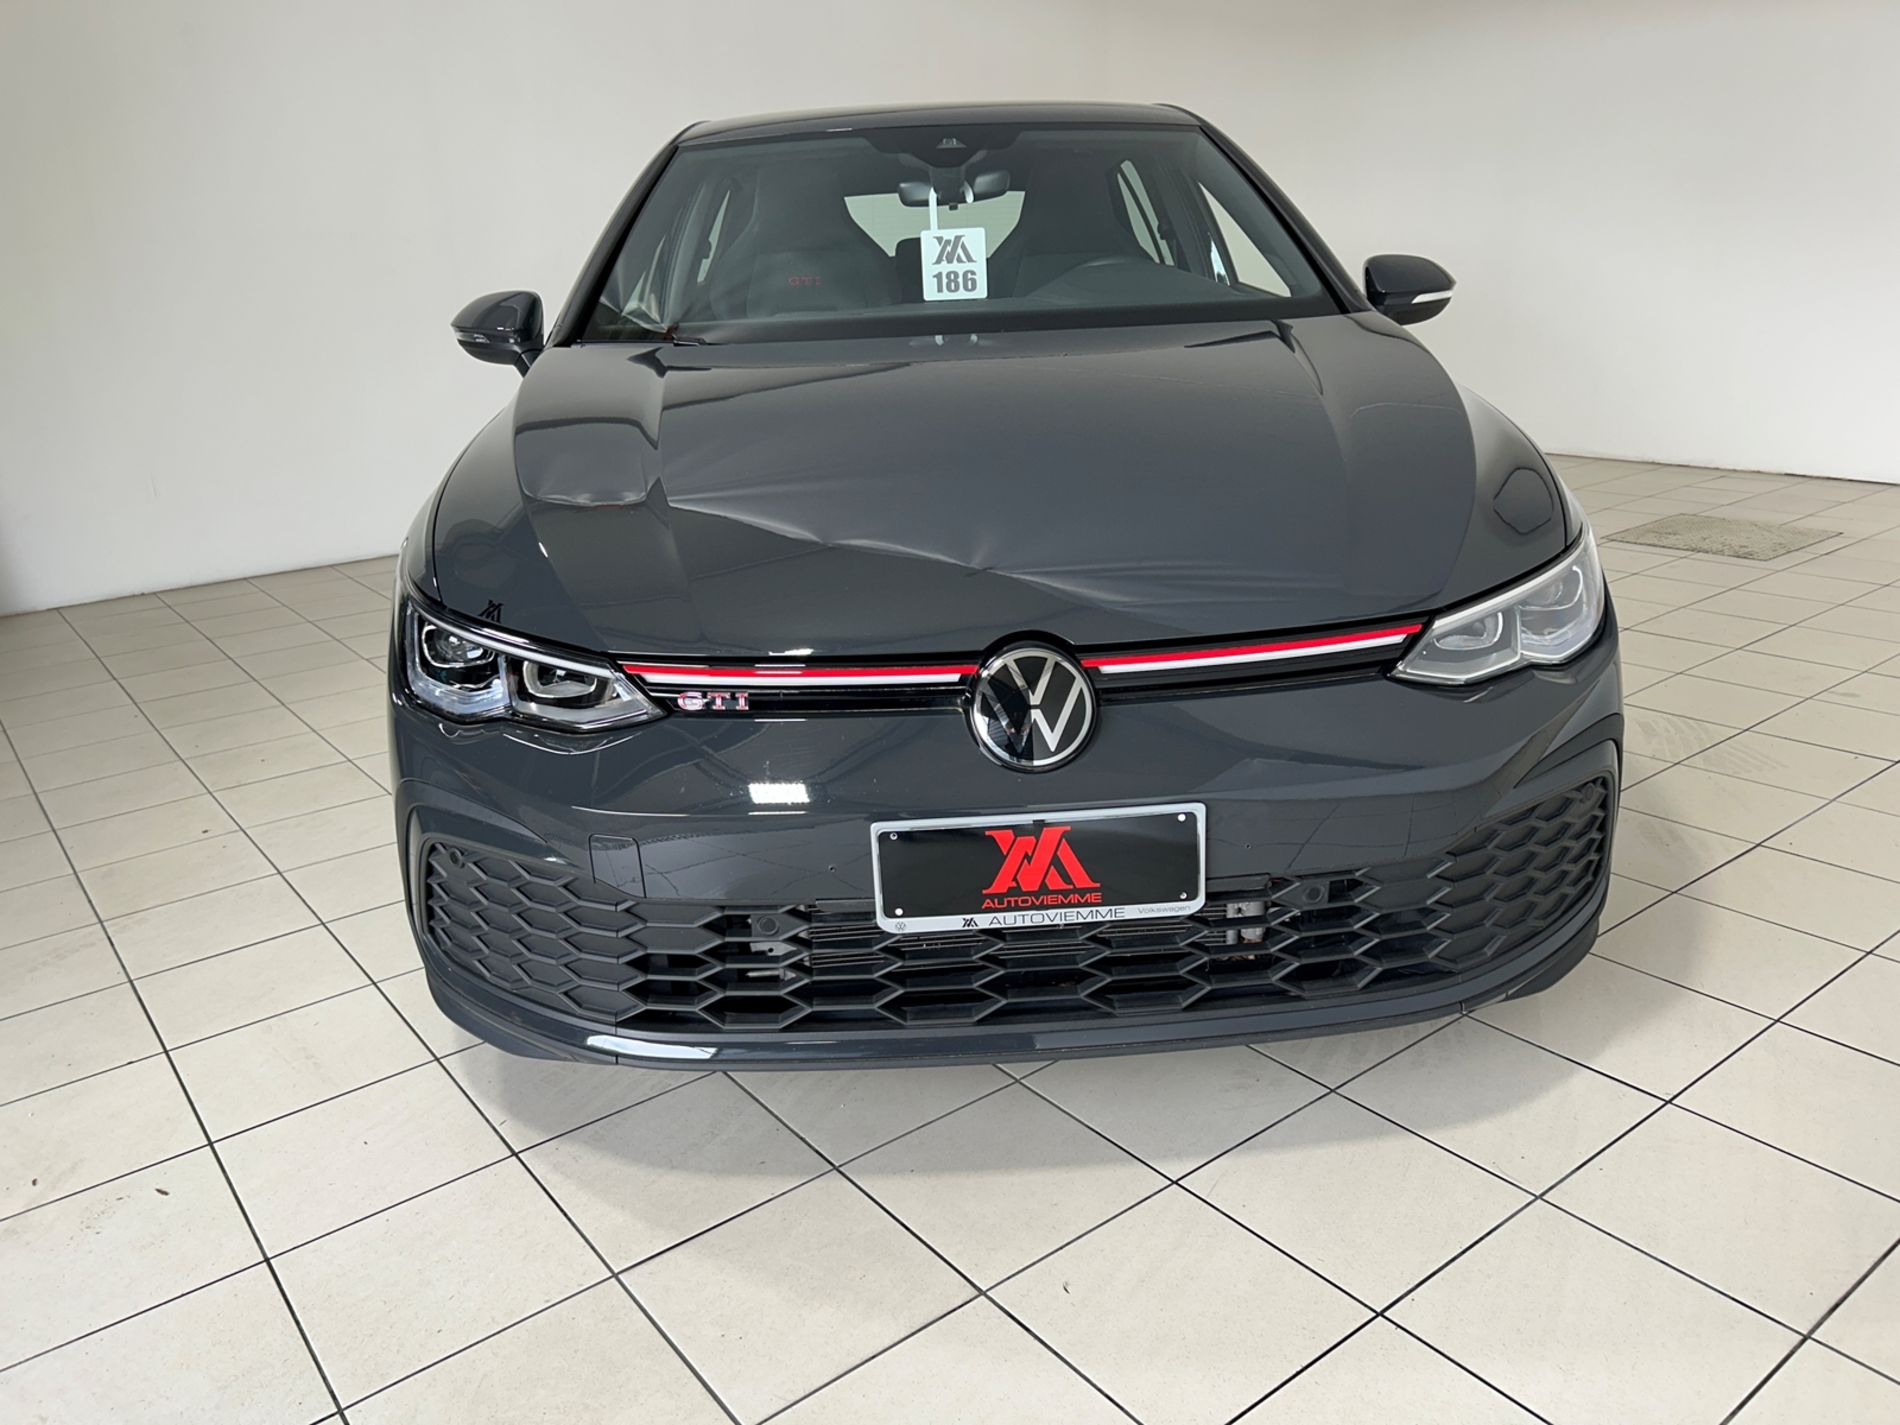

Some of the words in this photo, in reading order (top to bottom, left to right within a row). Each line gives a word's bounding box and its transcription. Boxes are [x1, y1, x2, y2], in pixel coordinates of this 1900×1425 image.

[932, 270, 978, 293] 186
[678, 691, 749, 711] GTI
[982, 893, 1103, 909] AUTOVIEMME
[1137, 904, 1191, 915] Volkswagen
[988, 907, 1126, 927] AUTOVIEMME
